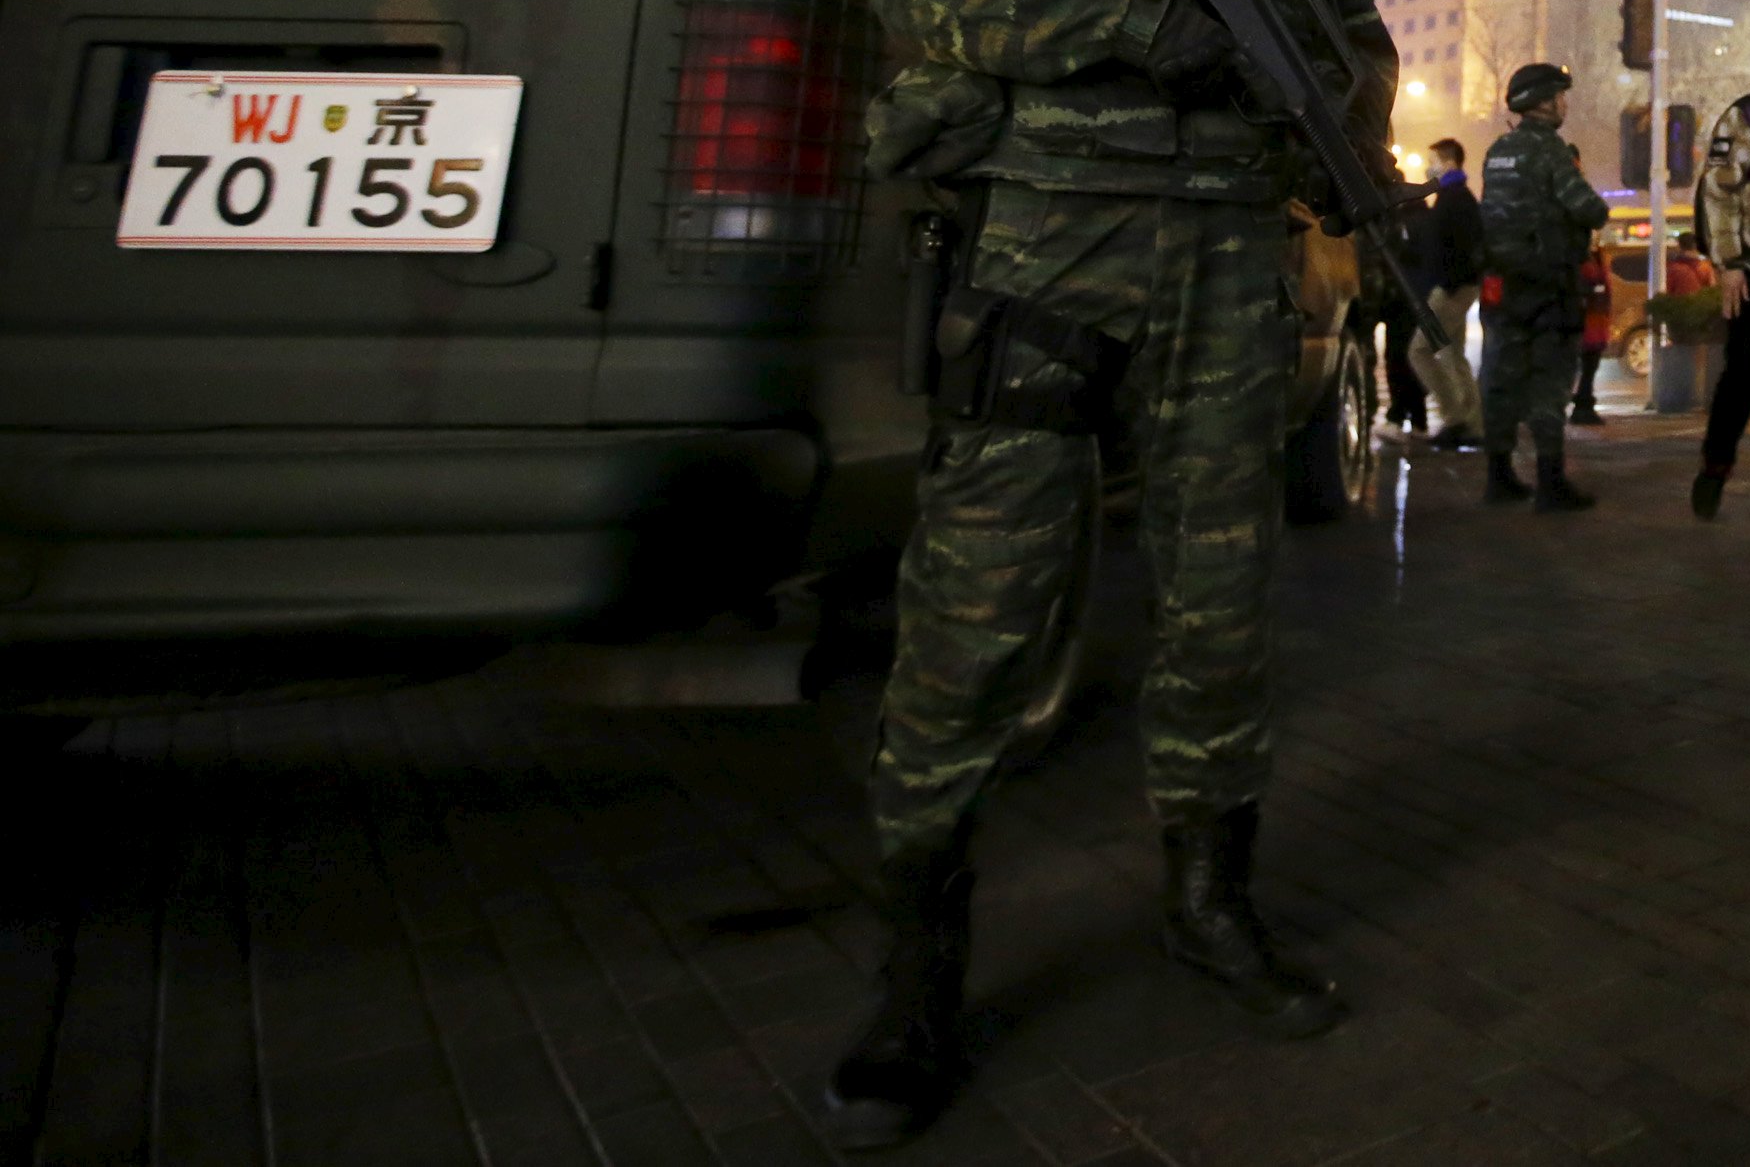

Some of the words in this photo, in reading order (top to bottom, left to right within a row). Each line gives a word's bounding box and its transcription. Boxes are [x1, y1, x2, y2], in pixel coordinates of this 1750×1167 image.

[231, 94, 303, 144] WJ
[367, 90, 436, 146] 京
[153, 154, 484, 228] 70155
